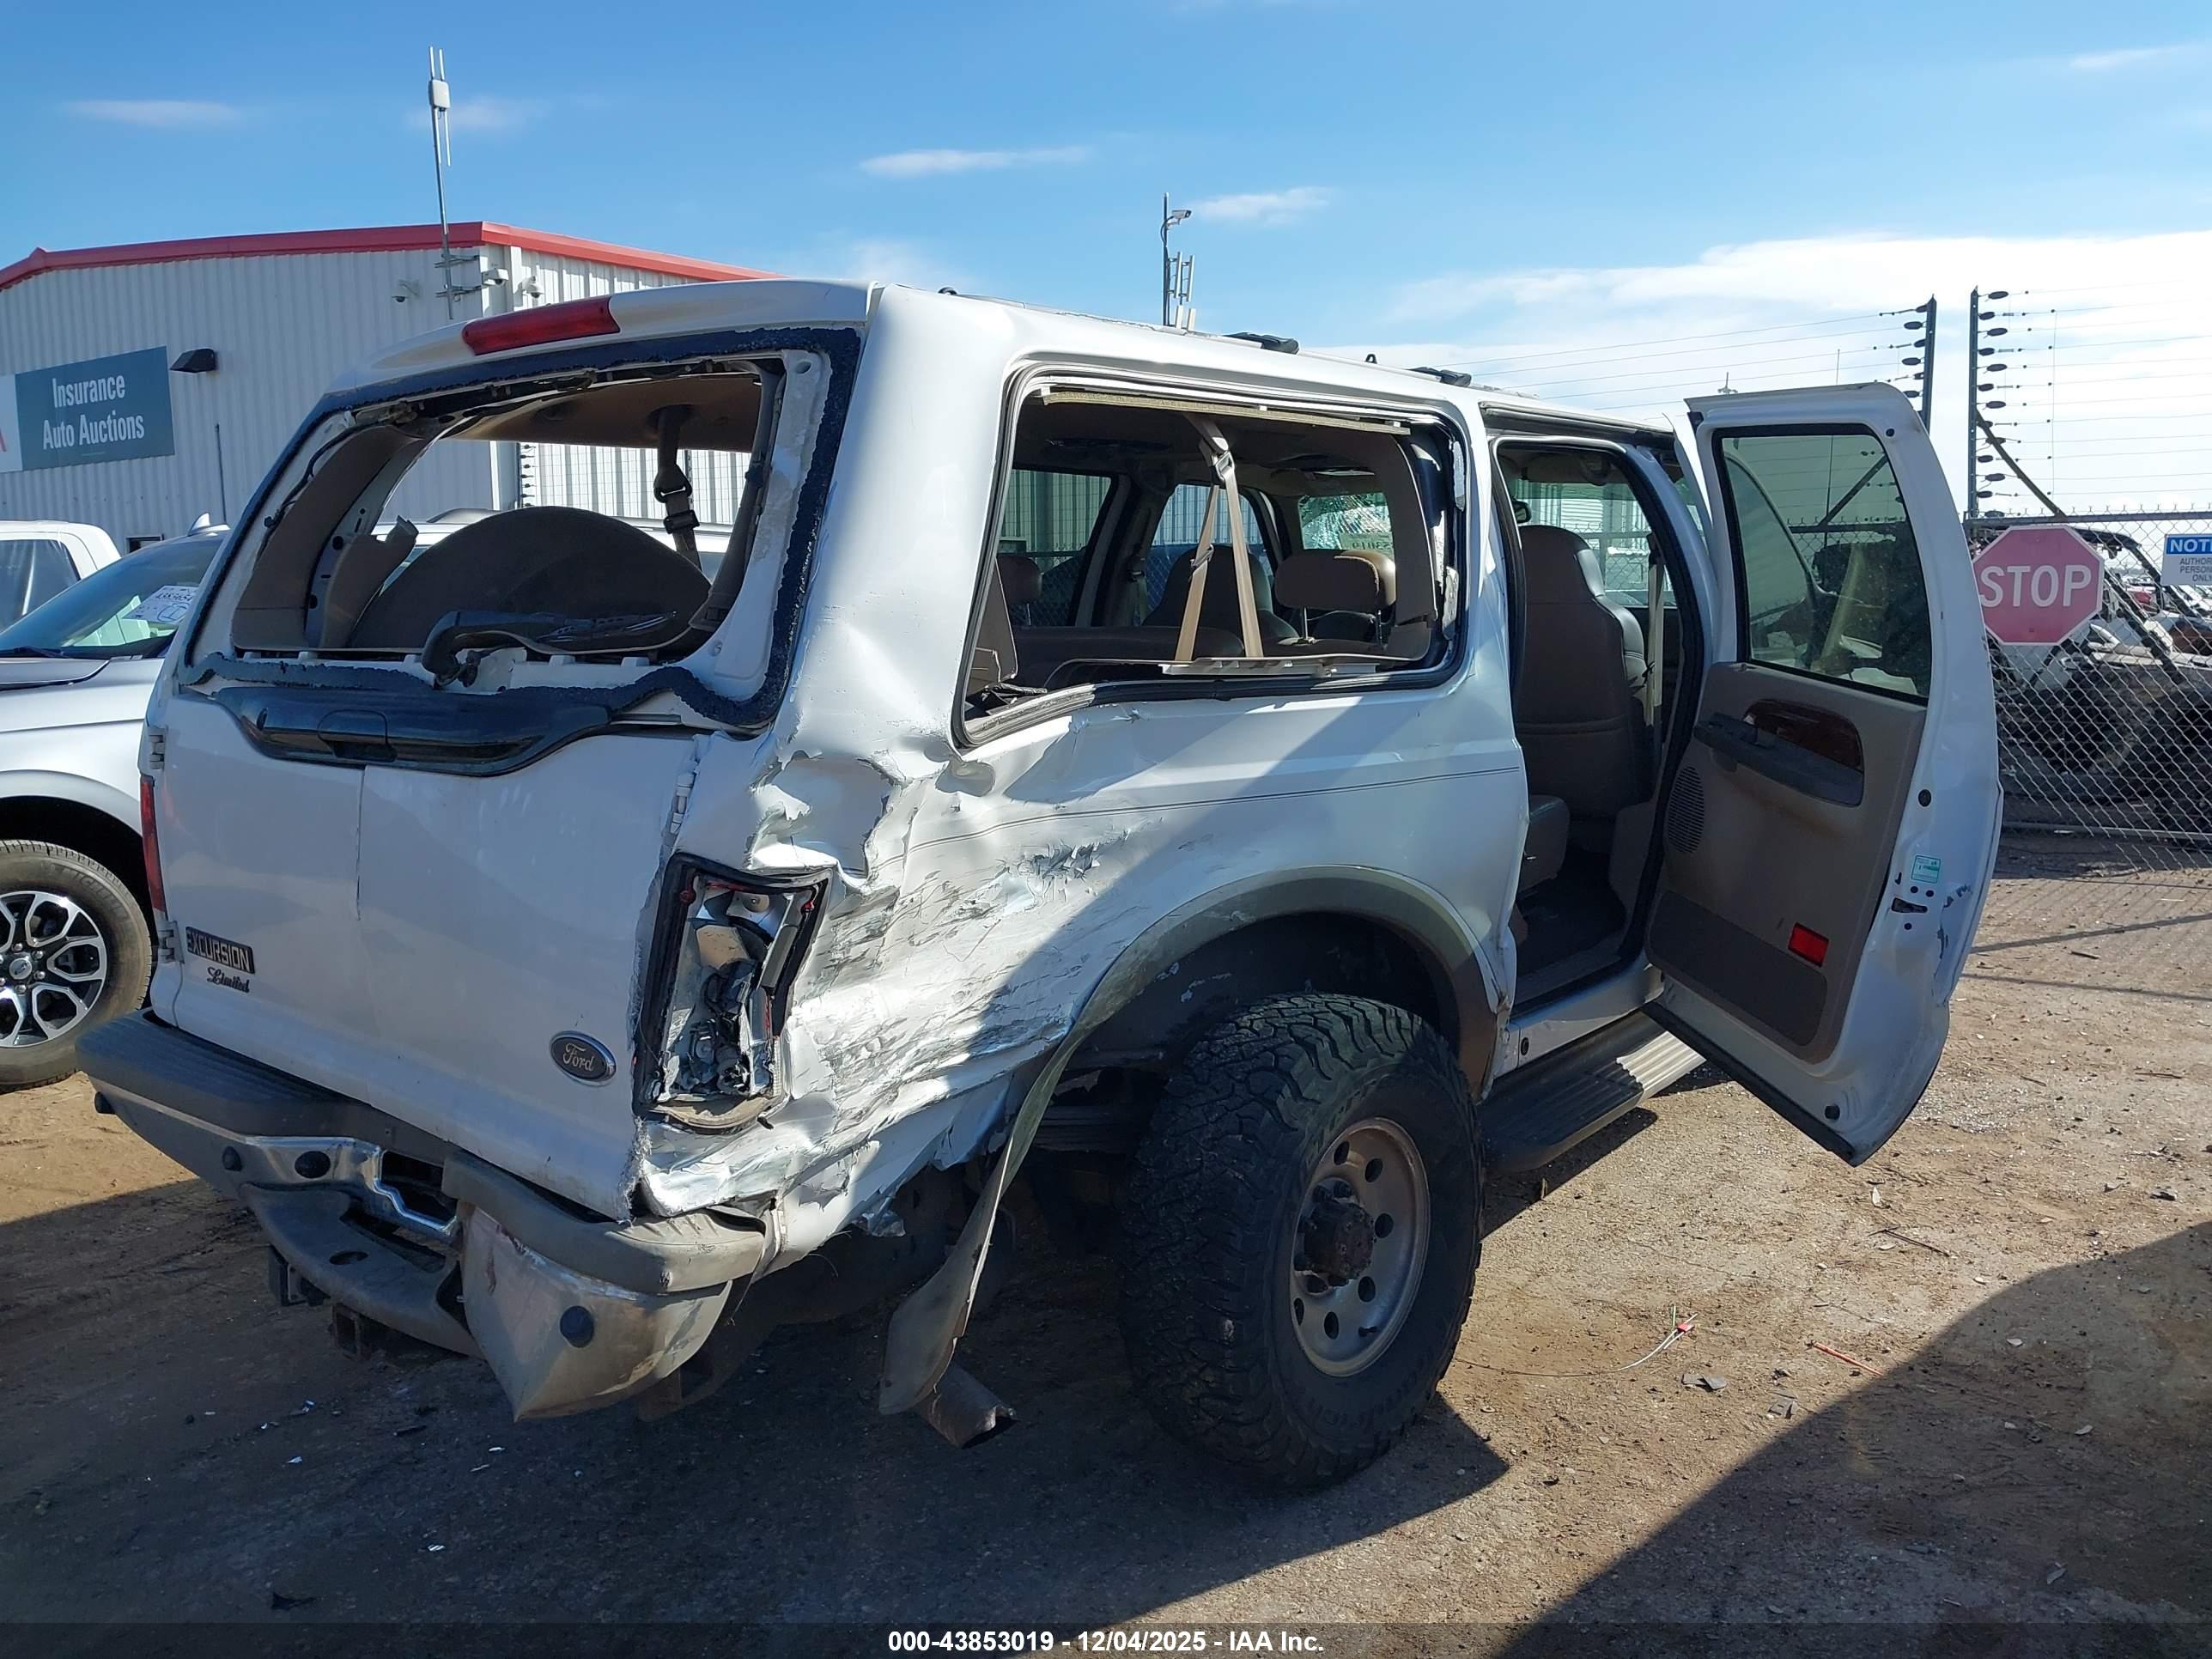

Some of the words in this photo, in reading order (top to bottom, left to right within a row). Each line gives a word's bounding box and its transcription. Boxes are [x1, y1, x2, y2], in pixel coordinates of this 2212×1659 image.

[52, 375, 125, 408] Insurance
[43, 419, 75, 450] Auto
[79, 410, 144, 446] Auctions
[1980, 565, 2092, 607] STOP
[186, 929, 250, 972] EXCURSION
[207, 967, 250, 994] Limited
[563, 1042, 595, 1072] Ford
